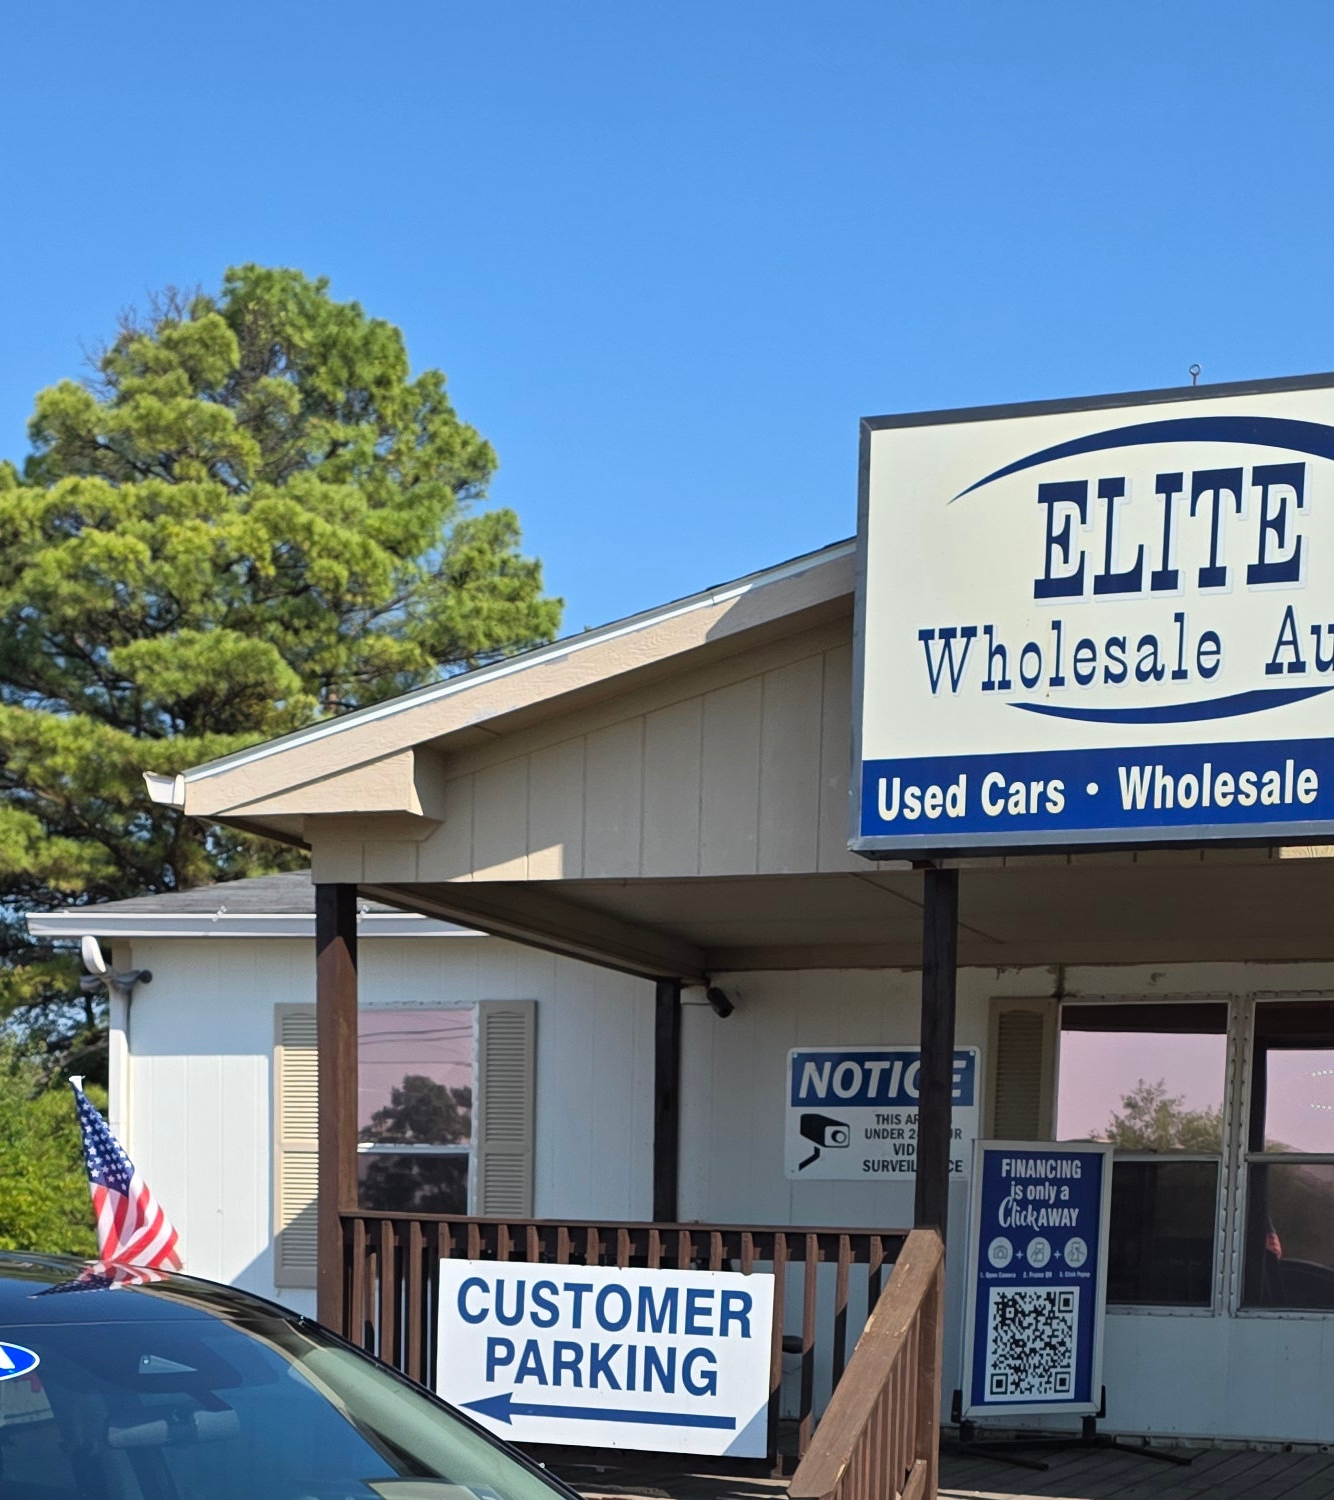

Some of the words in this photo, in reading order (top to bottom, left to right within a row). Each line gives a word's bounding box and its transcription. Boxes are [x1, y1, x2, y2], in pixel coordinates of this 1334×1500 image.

[1034, 462, 1307, 601] ELITE
[918, 612, 1223, 695] Wholesale
[877, 773, 968, 821] Used
[980, 770, 1066, 815] Cars
[1117, 761, 1319, 811] Wholesale
[865, 1128, 905, 1140] UNDER
[875, 1114, 902, 1125] THIS
[862, 1160, 963, 1173] SURVEILCE
[1001, 1158, 1082, 1179] FINANCING
[1010, 1180, 1024, 1200] is
[1027, 1181, 1058, 1205] only
[1060, 1185, 1070, 1201] a
[457, 1276, 753, 1339] CUSTOMER
[485, 1336, 718, 1397] PARKING
